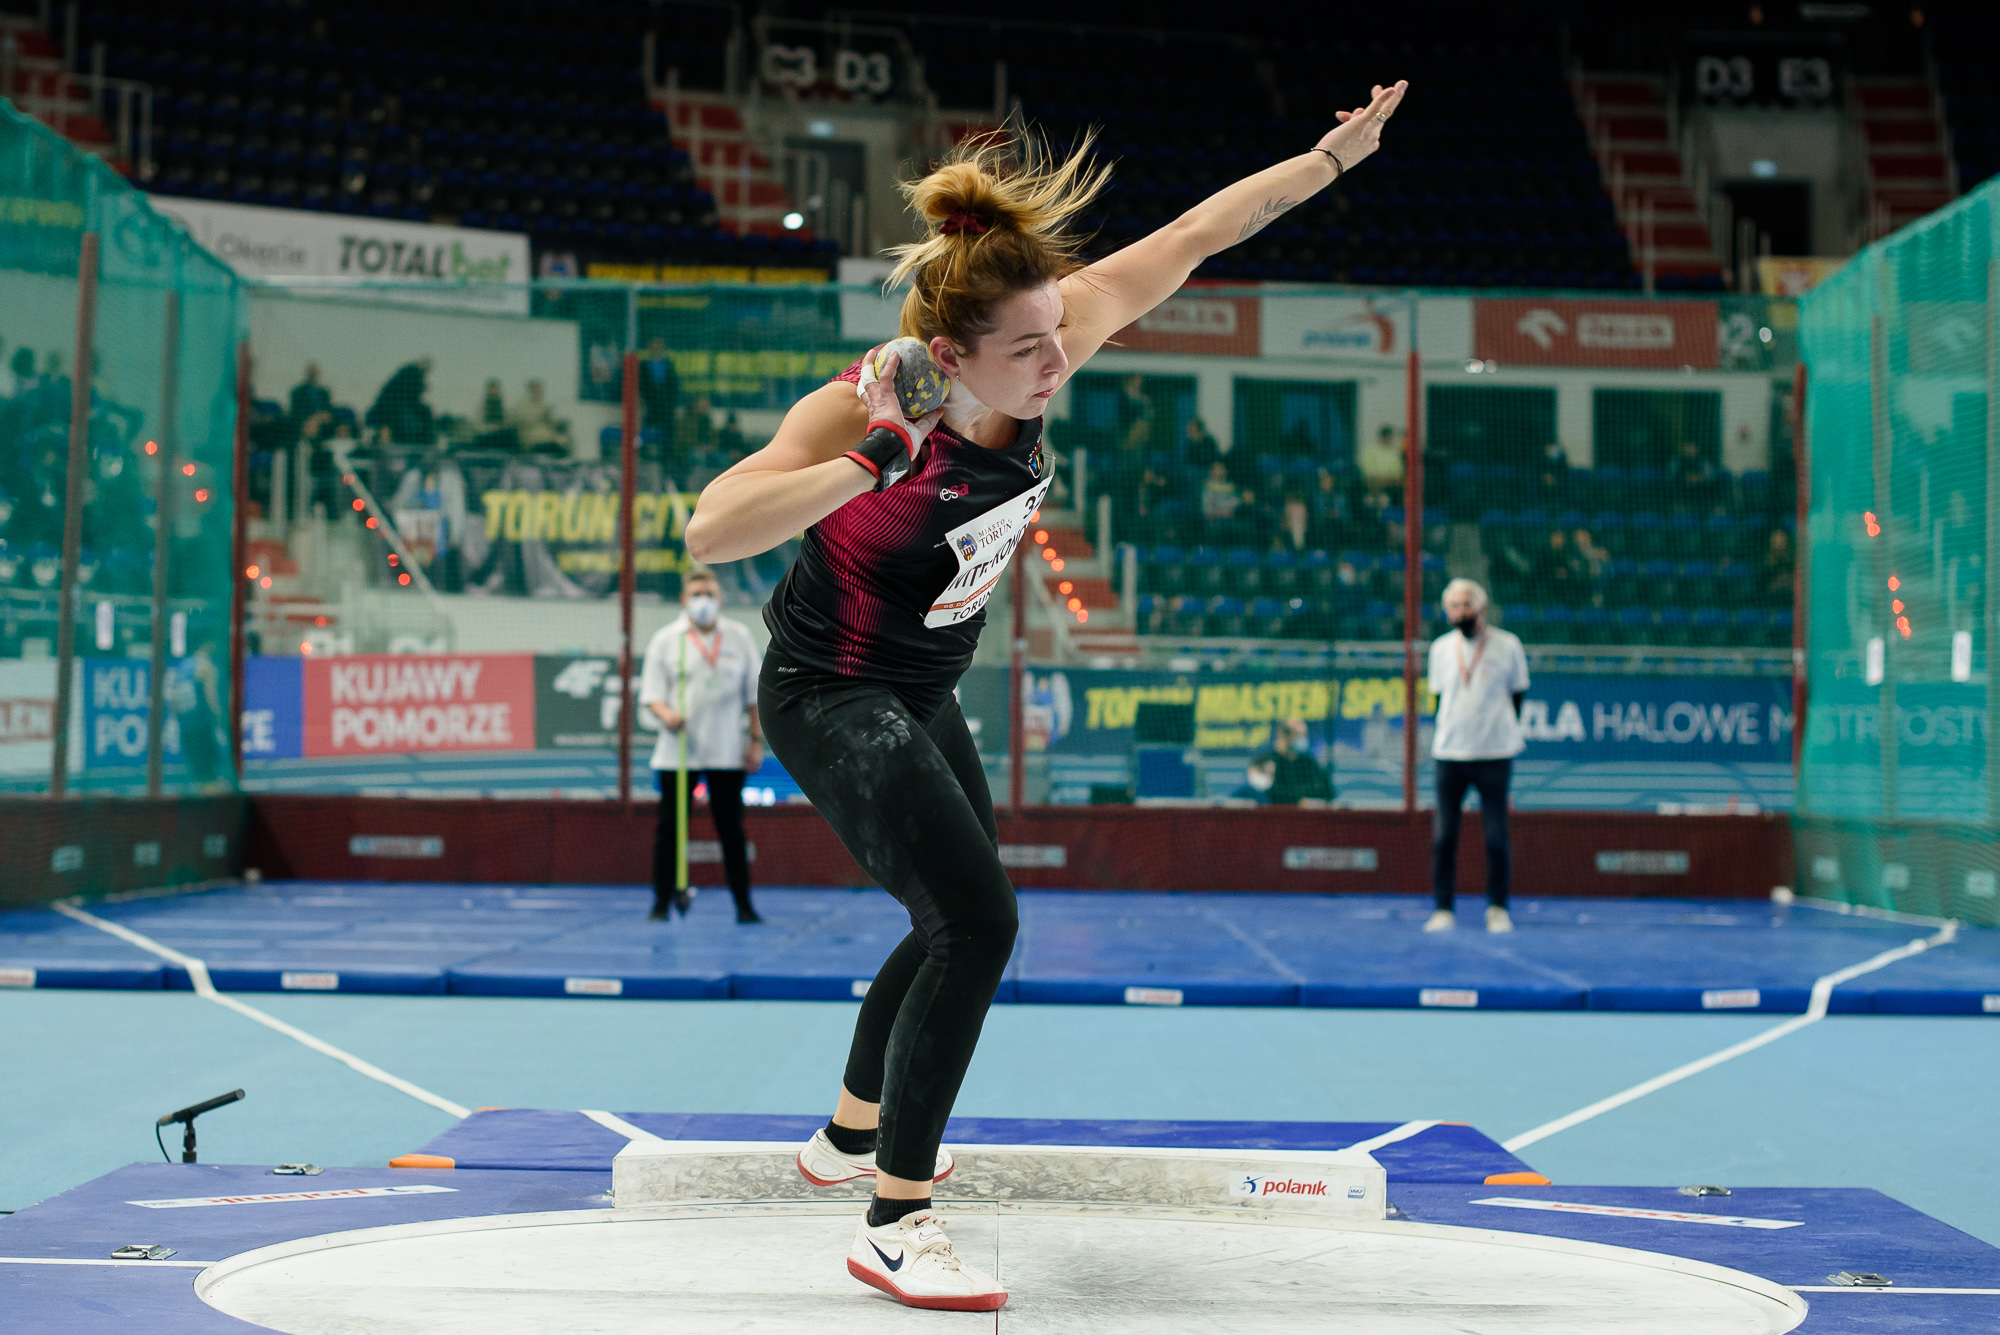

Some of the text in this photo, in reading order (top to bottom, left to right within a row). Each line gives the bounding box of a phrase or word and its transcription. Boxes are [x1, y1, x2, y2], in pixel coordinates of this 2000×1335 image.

[761, 45, 891, 93] C3 D3
[1697, 56, 1832, 98] D3 E3
[978, 518, 1005, 538] MIASTO
[330, 660, 483, 704] KUJAWY
[330, 703, 513, 749] POMORZE
[1592, 701, 1761, 744] HALOWE
[1262, 1178, 1328, 1197] polanik
